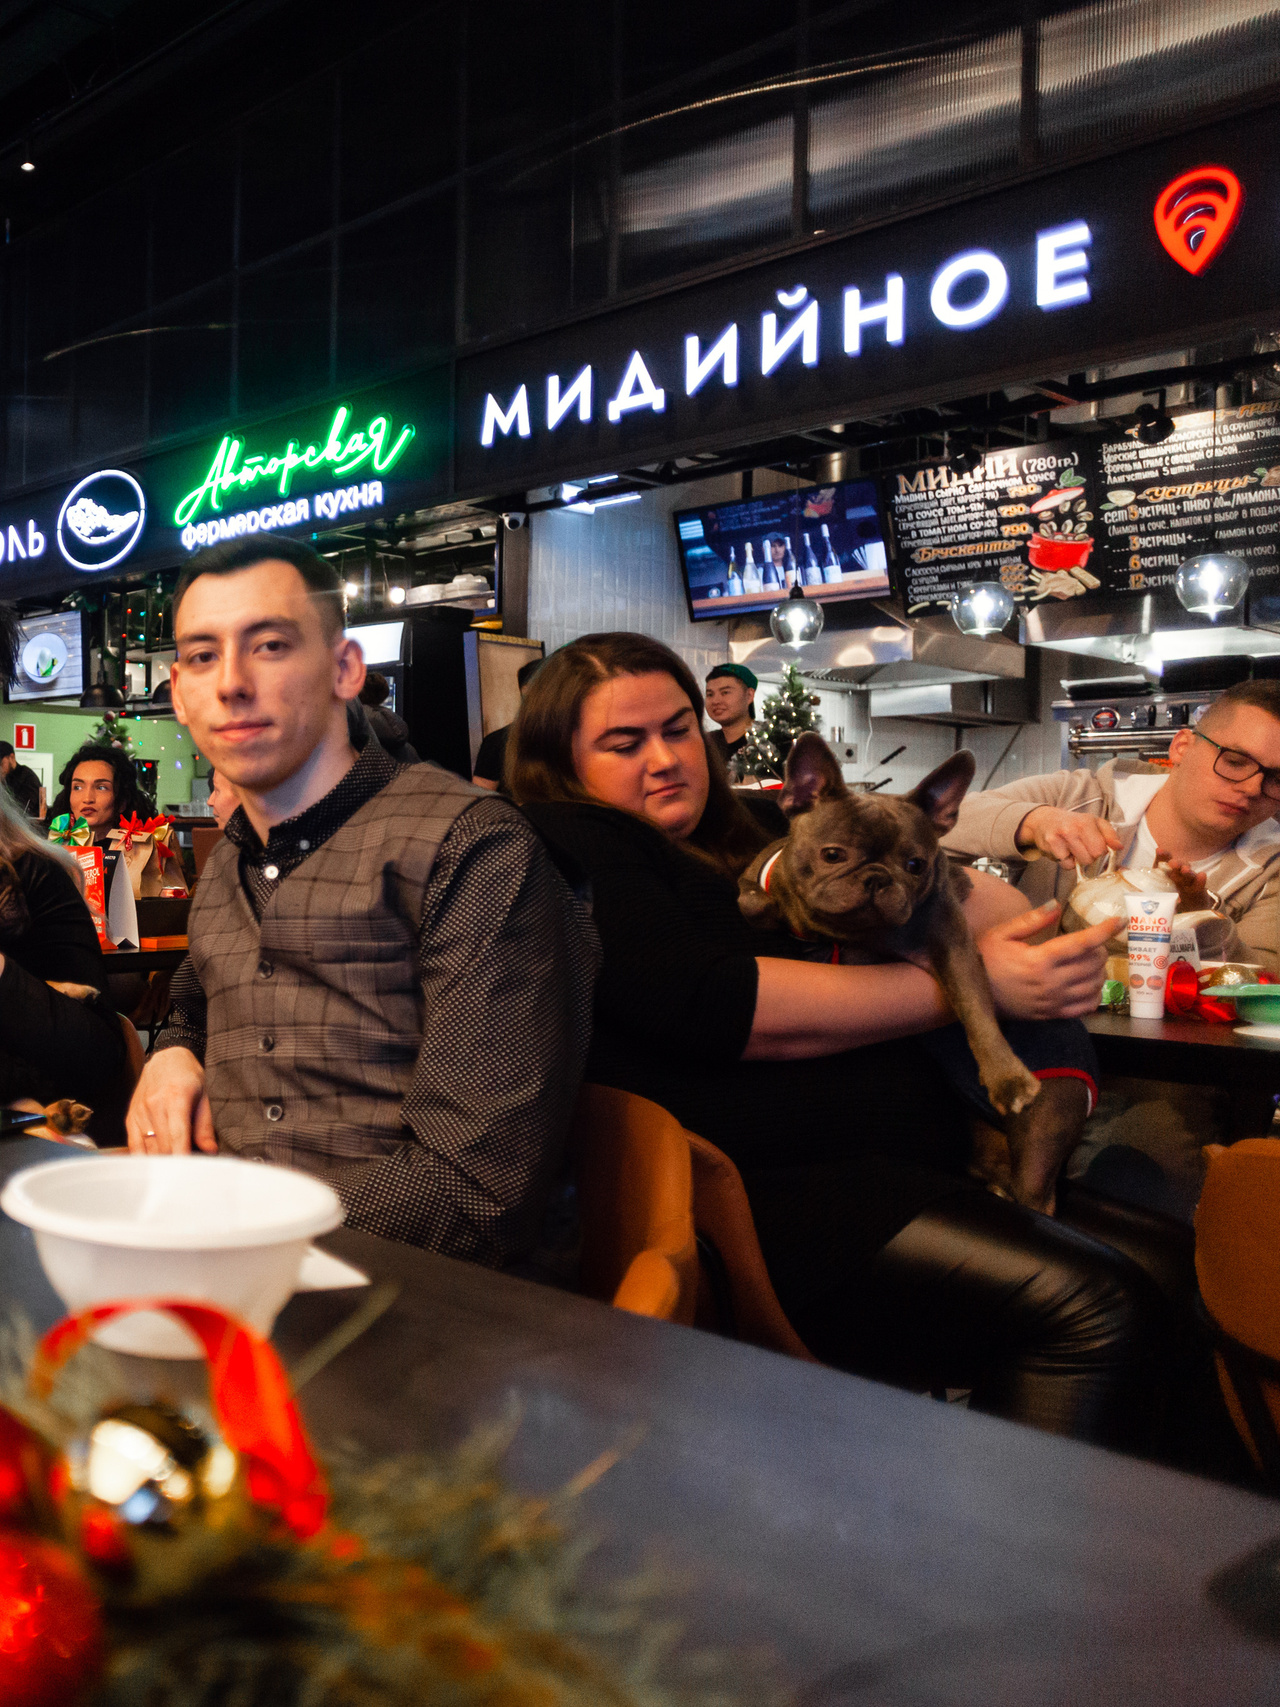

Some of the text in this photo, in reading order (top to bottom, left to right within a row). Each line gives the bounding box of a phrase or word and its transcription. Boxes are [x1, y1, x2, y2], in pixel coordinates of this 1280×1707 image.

[480, 219, 1093, 447] МИДИЙНОЕ
[174, 403, 416, 526] Авторская
[1131, 916, 1168, 926] NANO
